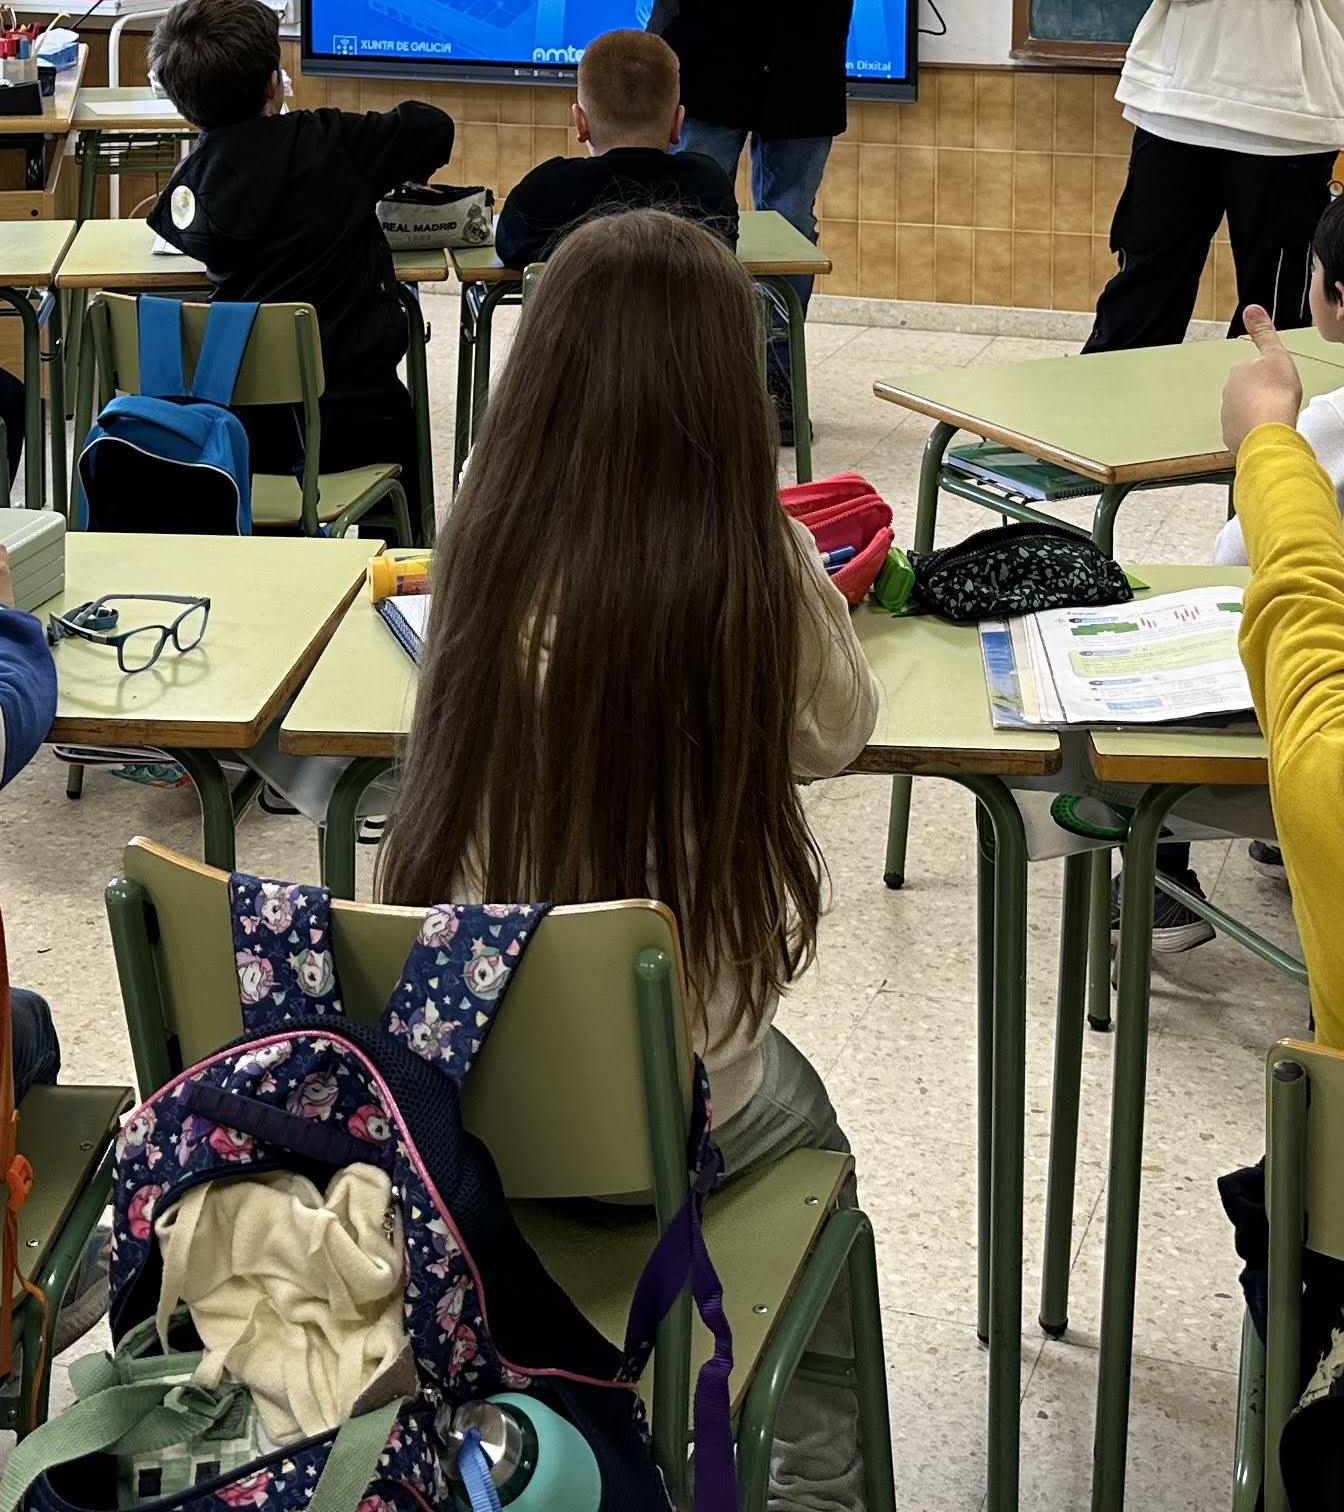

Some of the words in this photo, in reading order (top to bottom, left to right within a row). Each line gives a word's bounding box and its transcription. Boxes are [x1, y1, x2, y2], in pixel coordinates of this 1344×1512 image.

[360, 39, 395, 51] XUNTA
[396, 41, 410, 52] DE
[410, 42, 452, 54] GALICIA
[856, 60, 892, 71] Dixital
[382, 221, 411, 233] REAL
[413, 221, 457, 233] MADRID
